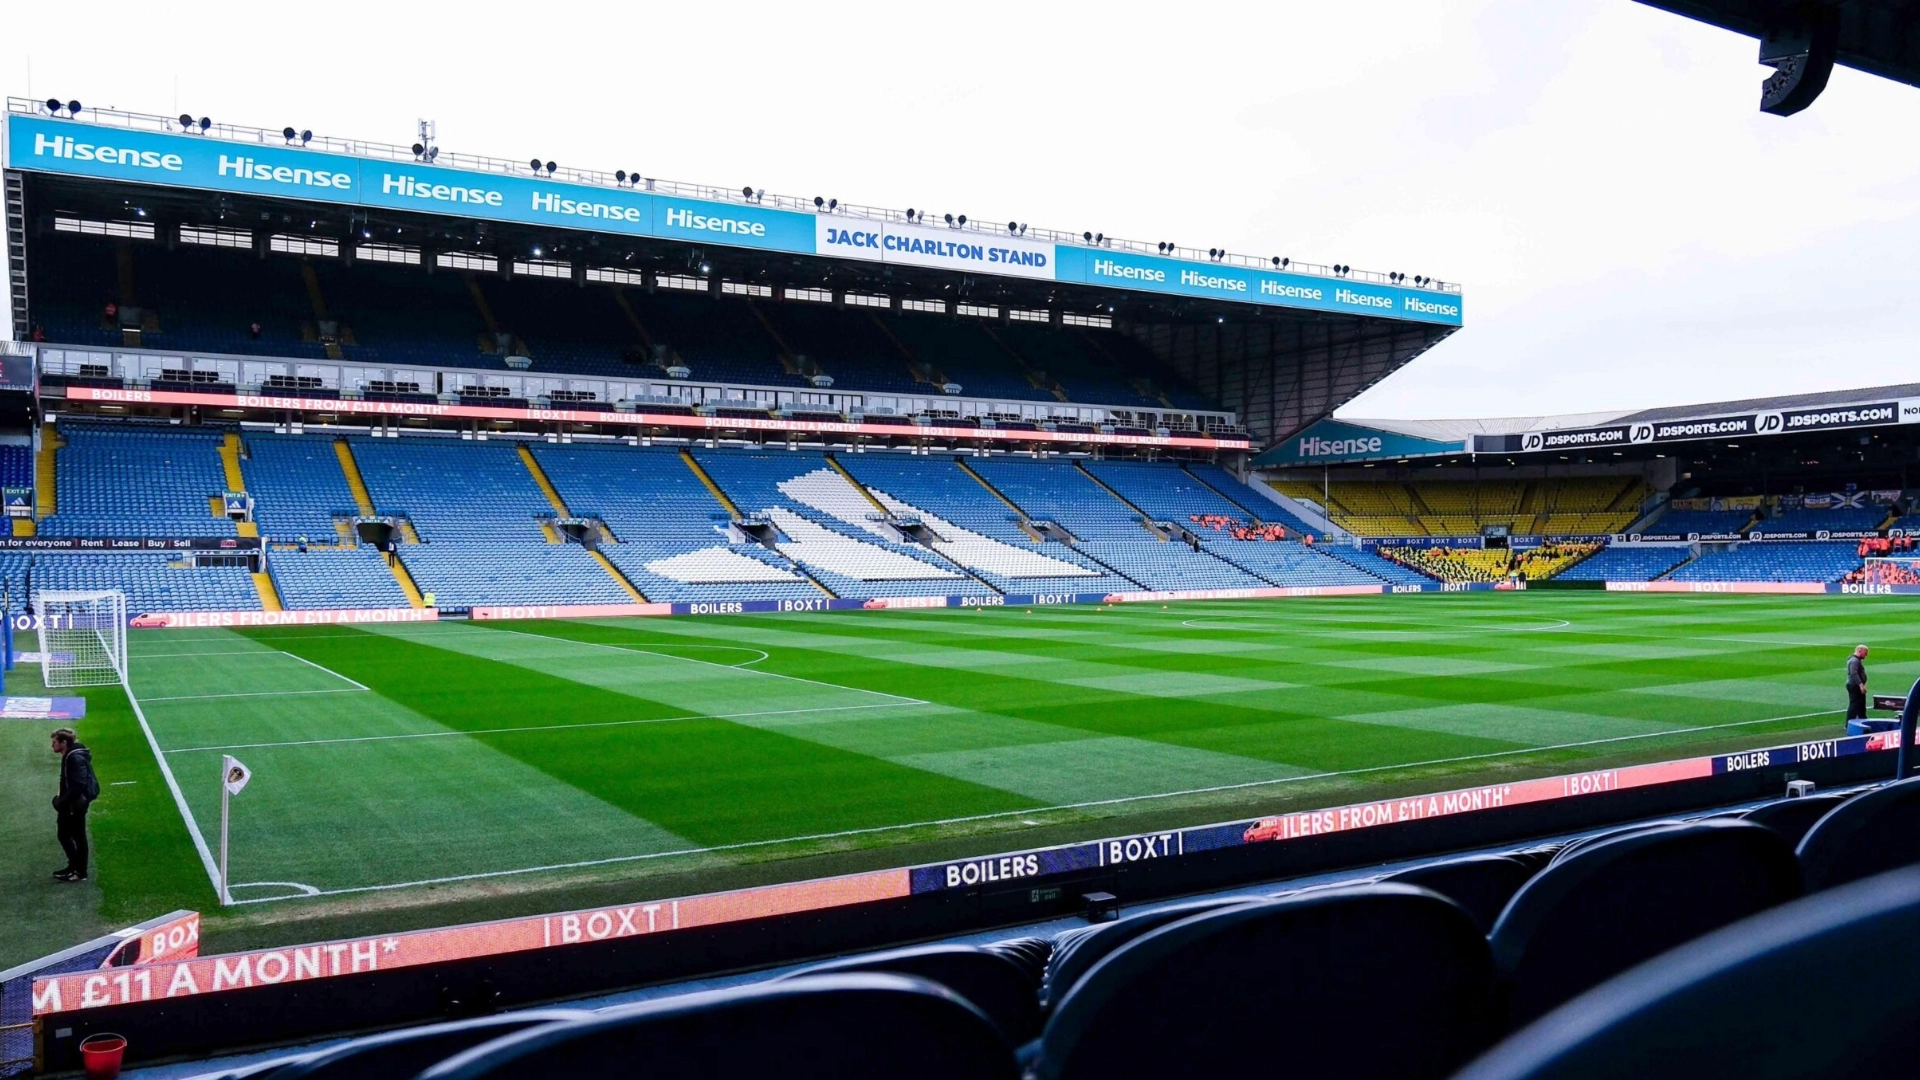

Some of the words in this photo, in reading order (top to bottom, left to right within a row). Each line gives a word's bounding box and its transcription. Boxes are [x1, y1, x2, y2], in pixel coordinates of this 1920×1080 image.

[34, 133, 183, 171] Hisense
[218, 155, 351, 190] Hisense
[382, 173, 503, 207] Hisense
[531, 191, 641, 223] Hisense
[666, 207, 766, 237] Hisense
[827, 228, 879, 249] JACK
[883, 235, 983, 261] CHARLTON
[988, 248, 1047, 267] STAND
[1094, 260, 1165, 282] Hisense
[1180, 269, 1247, 292] Hisense
[1260, 279, 1322, 300] Hisense
[1335, 288, 1393, 309] Hisense
[1404, 296, 1458, 316] Hisense
[92, 389, 151, 402] BOILERS
[237, 396, 300, 409] BOILERS
[305, 399, 348, 411] FROM
[353, 402, 374, 412] £11
[377, 403, 386, 413] A
[533, 410, 569, 421] BOXT
[600, 413, 643, 423] BOILERS
[1759, 415, 1780, 431] JD
[1787, 406, 1892, 427] JDSPORTS.COM
[1904, 407, 1920, 416] NO
[705, 418, 751, 428] BOILERS
[755, 420, 786, 429] FROM
[809, 422, 817, 431] A
[924, 427, 951, 436] BOXT
[974, 429, 1006, 437] BOILERS
[1633, 425, 1652, 441] JD
[1657, 420, 1747, 438] JDSPORTS.COM
[1053, 432, 1089, 441] BOILERS
[1091, 434, 1115, 442] FROM
[1299, 436, 1381, 457] Hisense
[1524, 436, 1542, 450] JD
[1545, 430, 1623, 447] JDSPORTS.COM
[148, 540, 166, 548] Buy
[1392, 584, 1421, 593] BOILERS
[1444, 583, 1467, 591] BOXT
[1695, 582, 1727, 592] BOXT
[1842, 584, 1891, 594] BOILERS
[690, 603, 742, 614] BOILERS
[784, 600, 822, 611] BOXT
[962, 596, 1004, 606] BOILERS
[1039, 594, 1069, 604] BOXT
[240, 611, 297, 625] FROM
[304, 611, 332, 624] £11
[337, 610, 350, 623] A
[502, 607, 547, 619] BOXT
[1727, 751, 1769, 772] BOILERS
[1802, 742, 1832, 761] BOXT
[1571, 772, 1610, 795] BOXT
[1340, 805, 1392, 832] FROM
[1398, 800, 1424, 822] £11
[1428, 797, 1439, 816] A
[1110, 834, 1172, 864] BOXT
[947, 855, 1038, 887] BOILERS
[561, 905, 661, 943] BOXT
[81, 969, 150, 1009] £11
[167, 962, 200, 998] A
